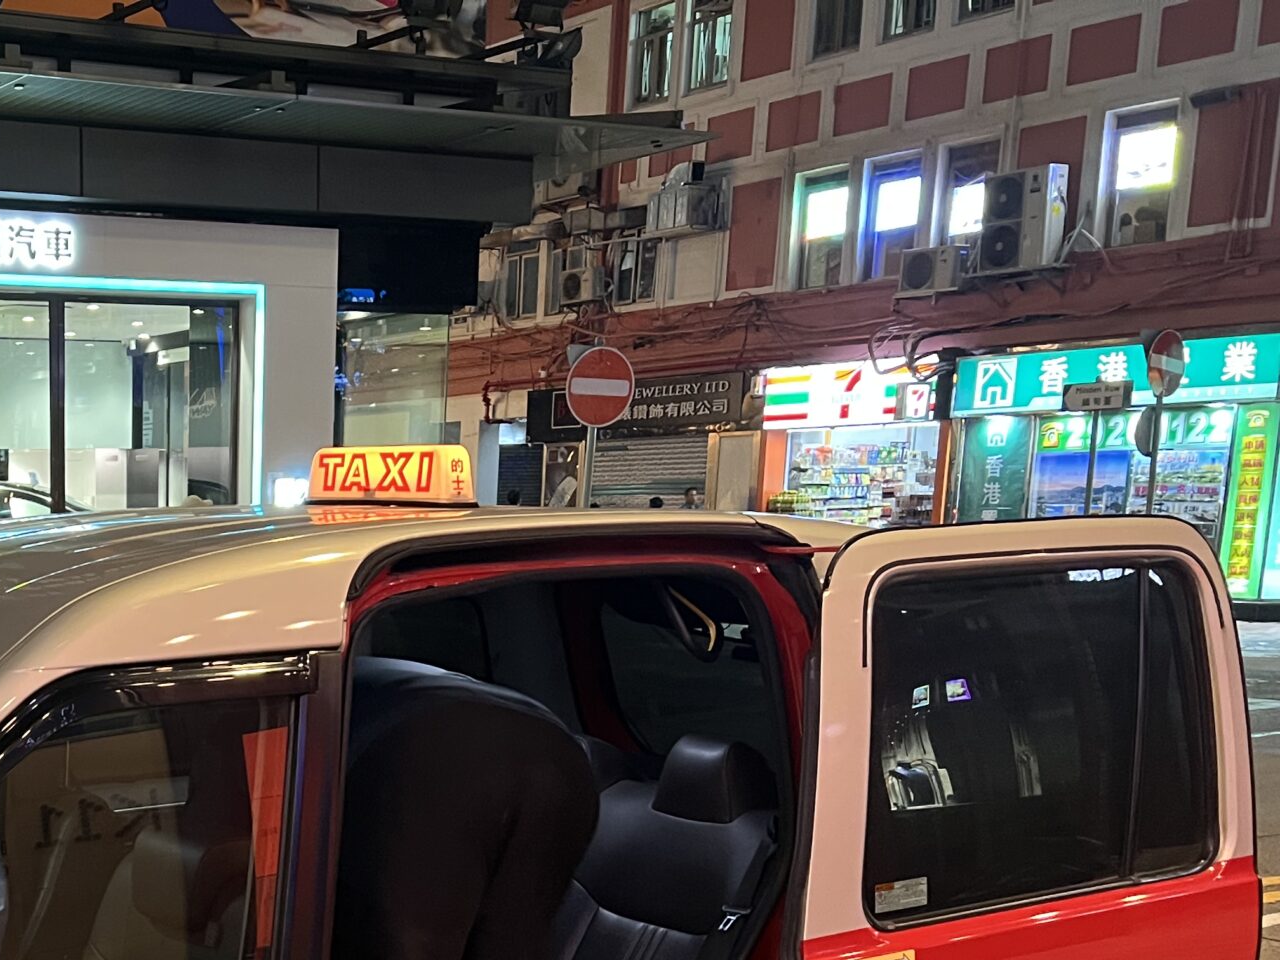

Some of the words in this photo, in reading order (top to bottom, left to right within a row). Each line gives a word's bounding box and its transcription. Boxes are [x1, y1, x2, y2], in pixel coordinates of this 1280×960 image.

[1039, 341, 1258, 394] 香港業
[634, 382, 700, 400] EWELLERY
[705, 380, 730, 394] LTD
[1075, 386, 1102, 395] Minden
[319, 451, 435, 493] TAXI
[450, 457, 465, 491] 的士
